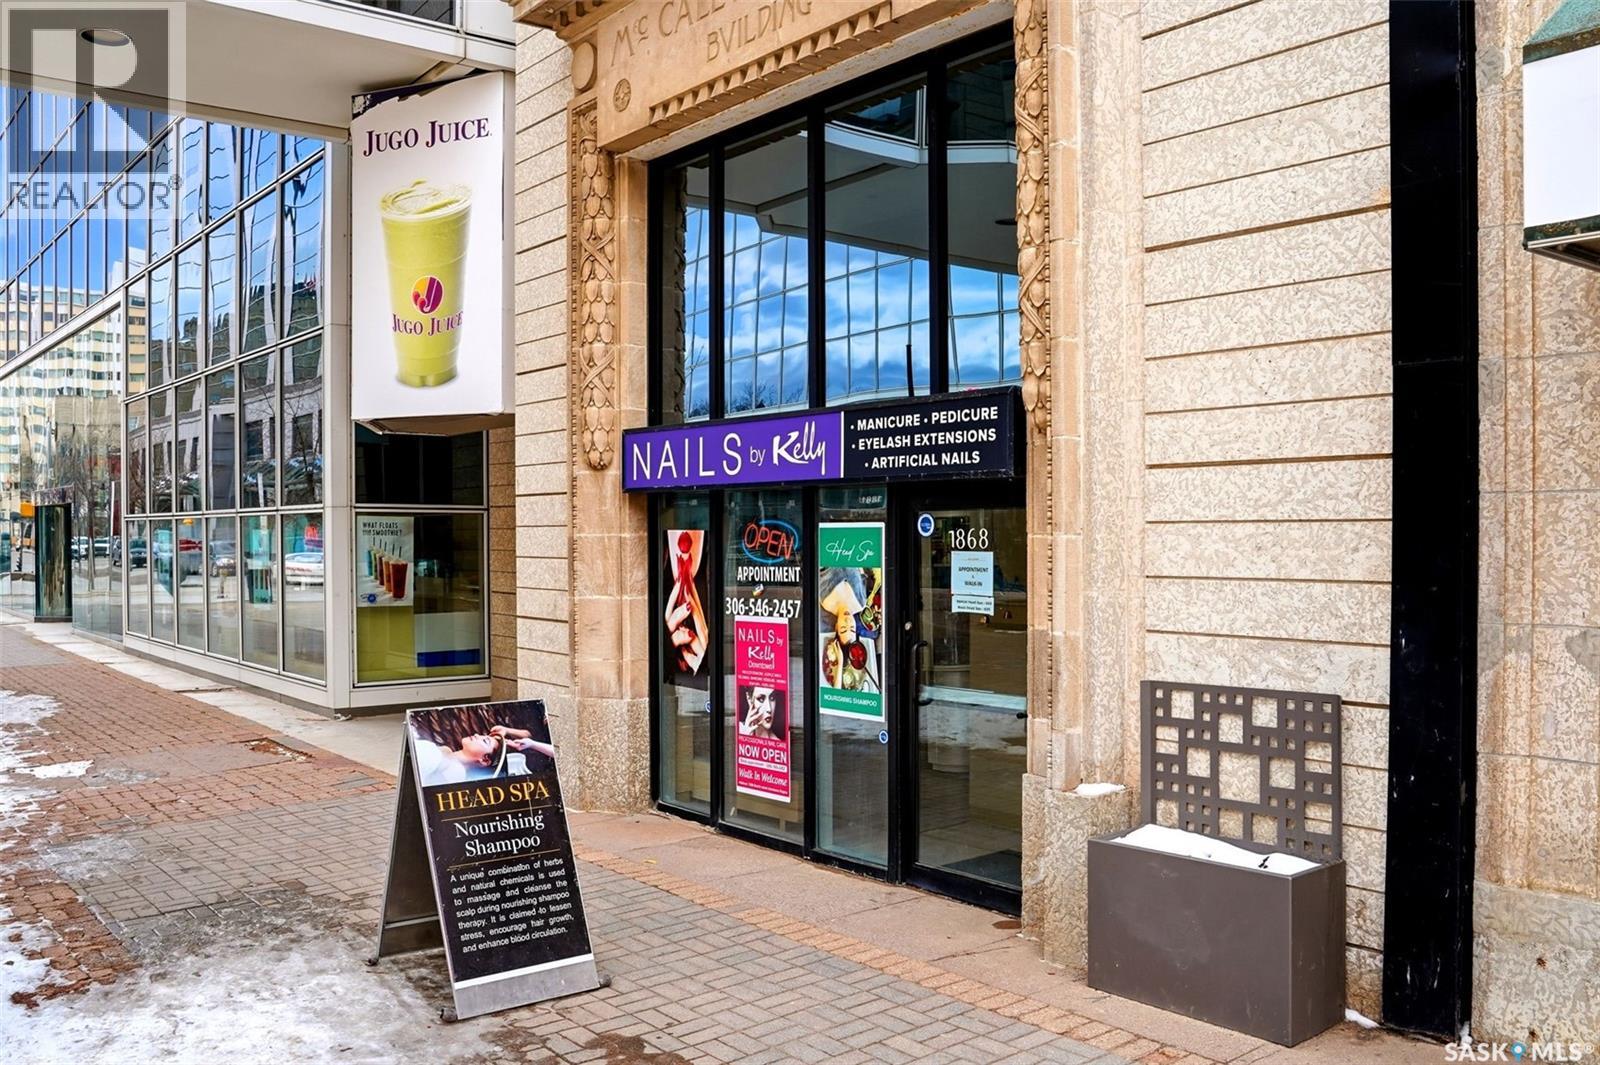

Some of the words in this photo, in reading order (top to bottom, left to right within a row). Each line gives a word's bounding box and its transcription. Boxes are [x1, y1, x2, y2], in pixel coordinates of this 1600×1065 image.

[363, 128, 419, 157] JUGO
[857, 413, 921, 431] MANICURE
[931, 406, 998, 424] PEDICURE
[633, 432, 742, 481] NAILS
[750, 446, 766, 467] by
[772, 420, 826, 476] Kelly
[858, 435, 911, 450] EYELASH
[914, 428, 996, 447] EXTENSIONS
[871, 453, 938, 469] ARTIFICIAL
[941, 451, 980, 465] NAILS
[744, 523, 794, 560] OPEN
[948, 527, 989, 549] 1868
[737, 566, 801, 582] APPOINTMENT
[725, 597, 801, 618] 306-546-2457
[738, 627, 776, 644] NAILS
[748, 644, 775, 669] Kelly
[738, 744, 760, 758] NOW
[761, 747, 787, 764] OPEN
[436, 786, 505, 812] HEAD
[509, 780, 551, 802] SPA
[453, 810, 545, 838] Nourishing
[465, 835, 541, 857] Shampoo
[450, 874, 457, 883] A
[460, 869, 485, 881] unique
[488, 863, 531, 877] combination
[533, 860, 541, 869] of
[543, 858, 564, 867] herbs
[452, 884, 467, 895] and
[470, 880, 496, 891] natural
[499, 873, 535, 886] chemicals
[538, 872, 545, 880] is
[548, 867, 566, 878] used
[454, 898, 463, 906] to
[466, 892, 501, 904] massage
[505, 887, 520, 897] and
[523, 882, 552, 894] cleanse
[555, 879, 568, 888] the
[456, 908, 476, 918] scalp
[476, 903, 501, 914] during
[501, 897, 538, 910] nourishing
[538, 891, 570, 903] shampoo
[458, 918, 488, 930] therapy.
[509, 907, 536, 920] claimed
[549, 902, 572, 912] lessen
[460, 931, 485, 942] stress,
[489, 923, 528, 936] encourage
[530, 918, 545, 928] hair
[462, 943, 477, 953] and
[478, 937, 510, 950] enhance
[510, 932, 530, 944] blood
[531, 926, 569, 939] circulation.
